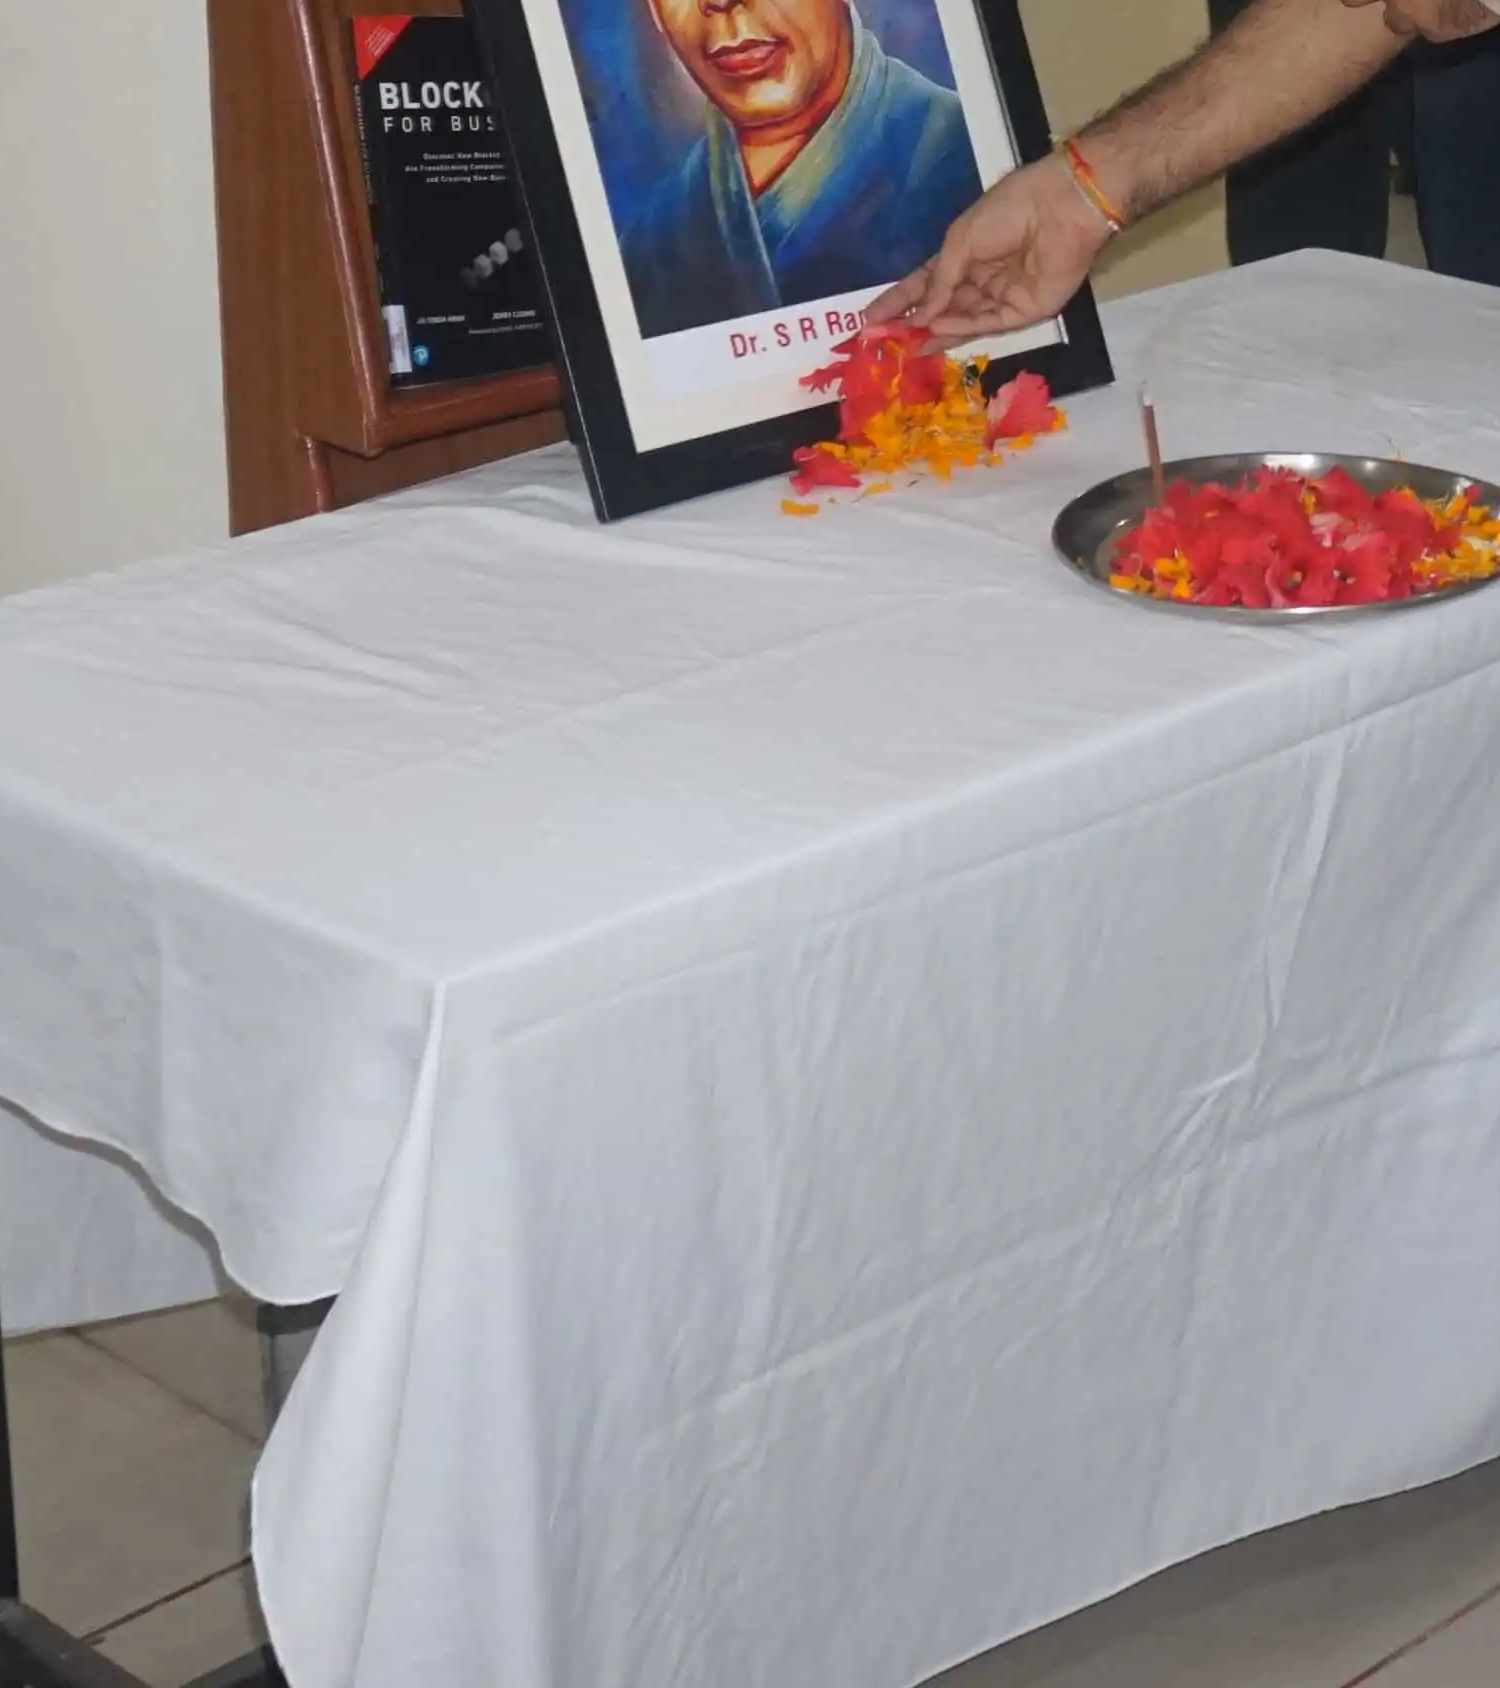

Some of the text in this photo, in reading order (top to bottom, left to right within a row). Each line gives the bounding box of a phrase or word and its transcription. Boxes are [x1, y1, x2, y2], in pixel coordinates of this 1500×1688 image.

[379, 81, 484, 110] BLOCK
[384, 115, 496, 132] FOR BUS
[730, 333, 767, 358] Dr.
[773, 322, 791, 348] S
[799, 317, 818, 342] R
